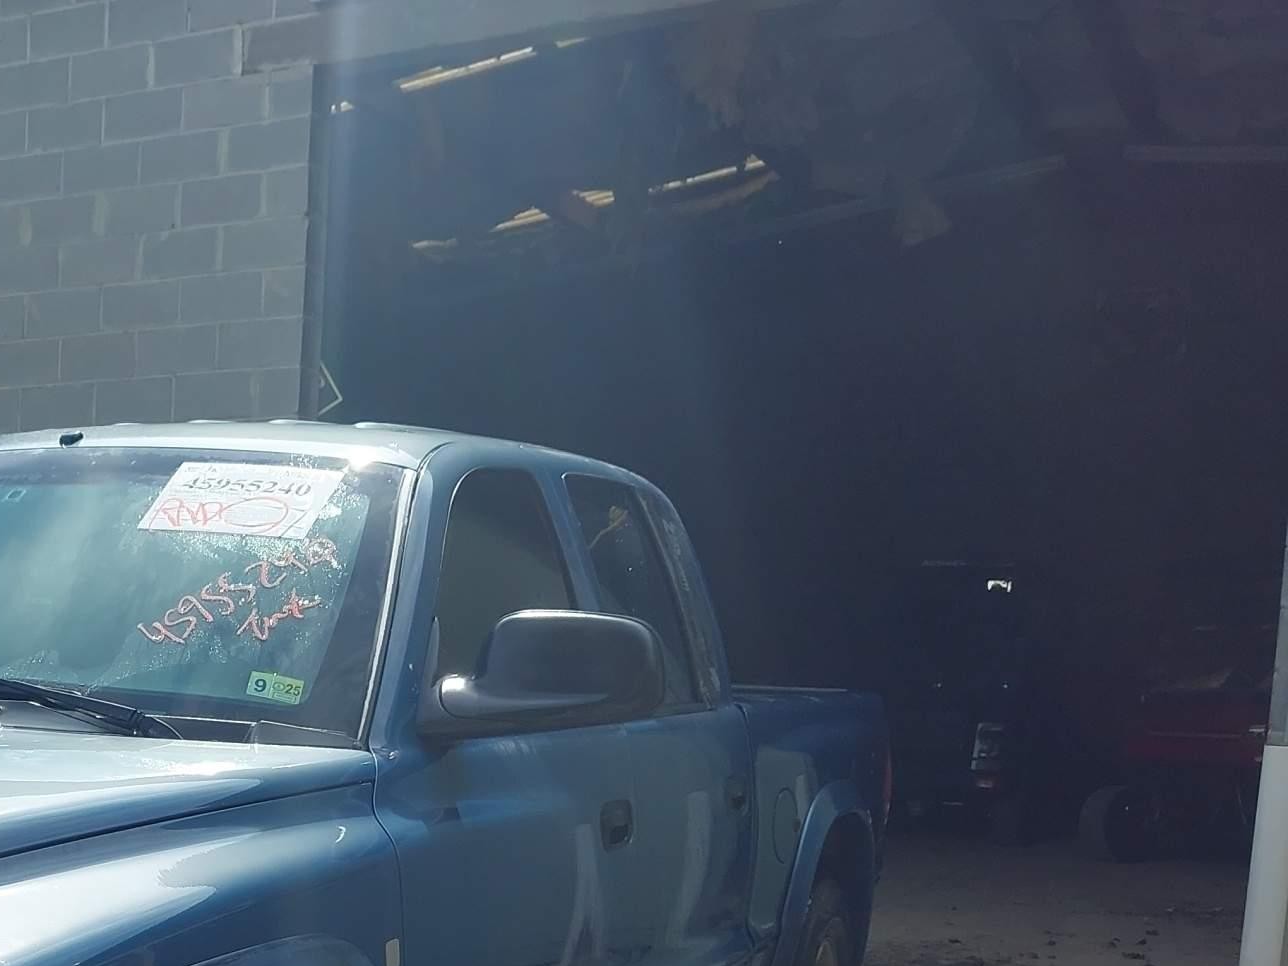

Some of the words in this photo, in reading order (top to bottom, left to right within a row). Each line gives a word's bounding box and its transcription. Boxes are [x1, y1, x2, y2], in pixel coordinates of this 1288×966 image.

[183, 476, 312, 497] 45955240
[253, 678, 267, 693] 9
[284, 683, 302, 697] 25
